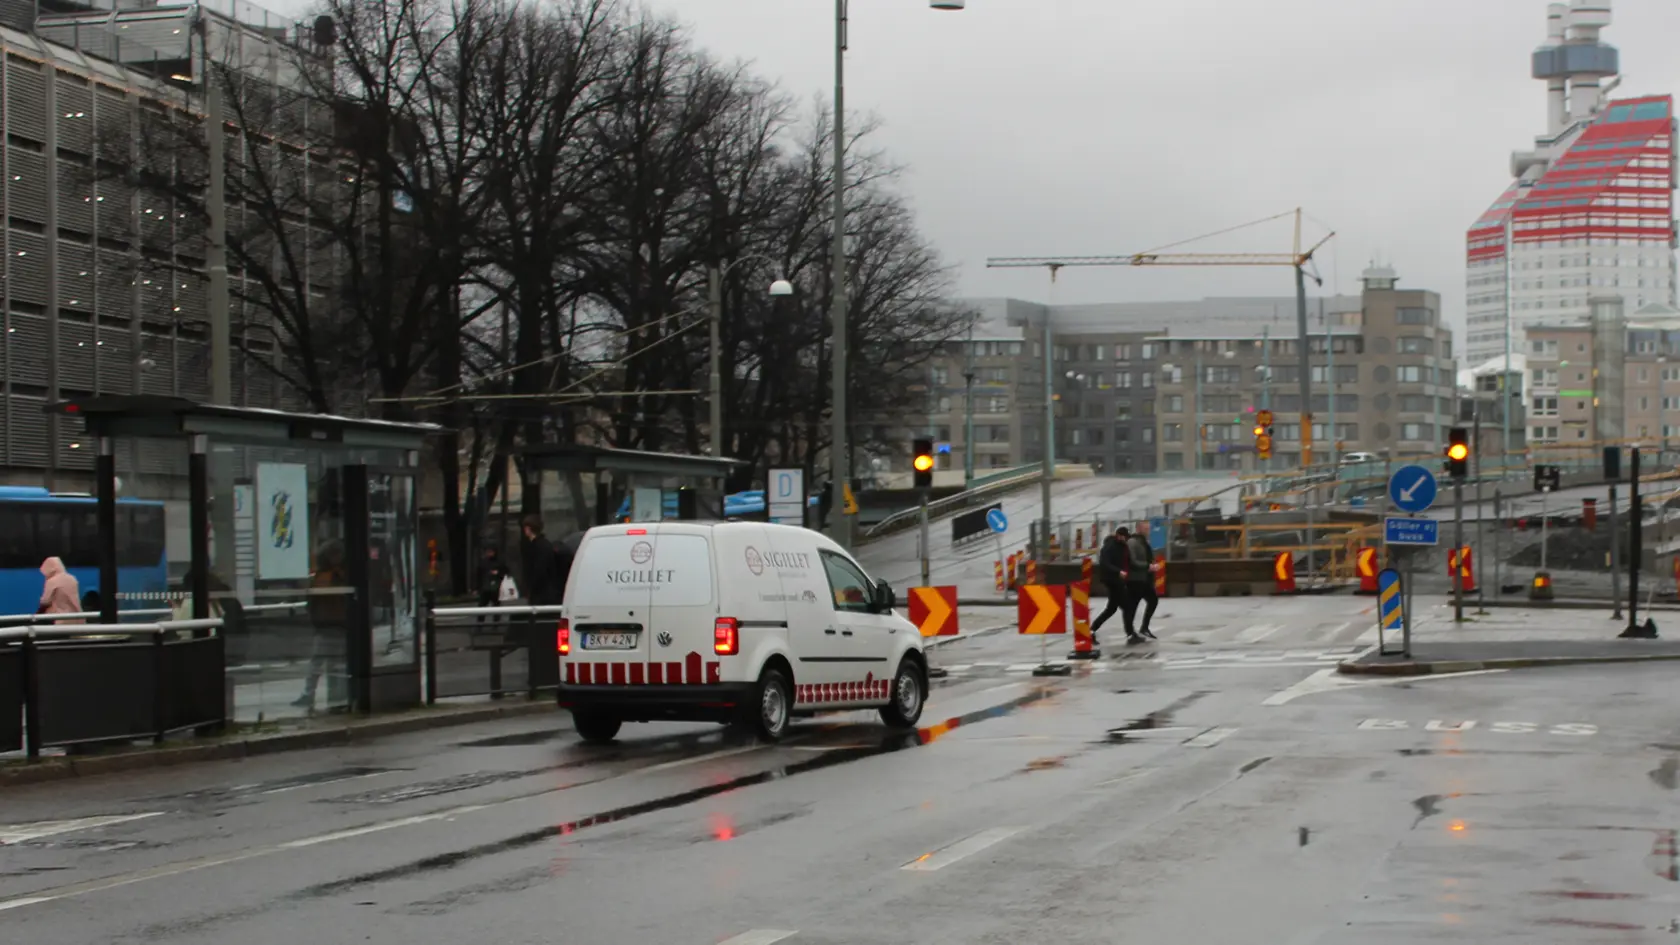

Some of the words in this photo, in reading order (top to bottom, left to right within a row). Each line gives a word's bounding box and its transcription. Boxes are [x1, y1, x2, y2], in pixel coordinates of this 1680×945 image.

[779, 473, 792, 497] D
[763, 551, 810, 569] SIGILLET
[606, 569, 676, 584] SIGILLET
[1357, 718, 1598, 736] BUSS
